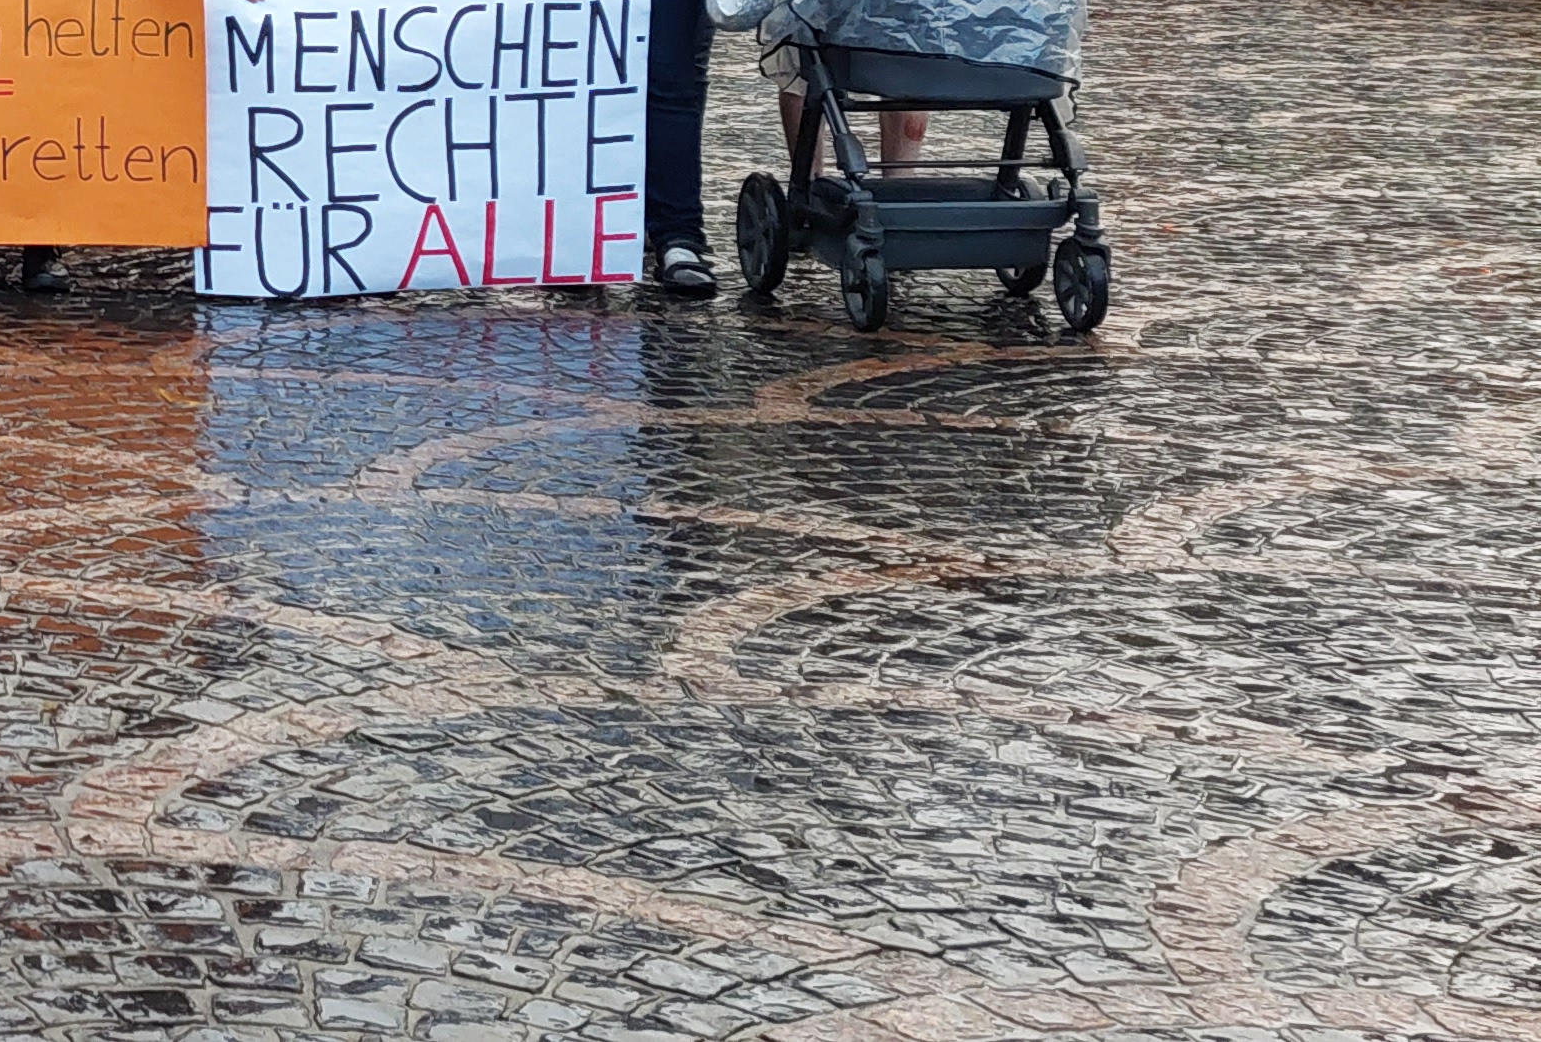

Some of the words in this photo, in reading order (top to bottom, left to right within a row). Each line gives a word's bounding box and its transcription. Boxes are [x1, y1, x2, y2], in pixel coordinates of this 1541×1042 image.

[1, 115, 198, 184] retten
[248, 86, 639, 204] RECHTE
[202, 201, 372, 298] FÜR
[397, 192, 639, 290] ALLE
